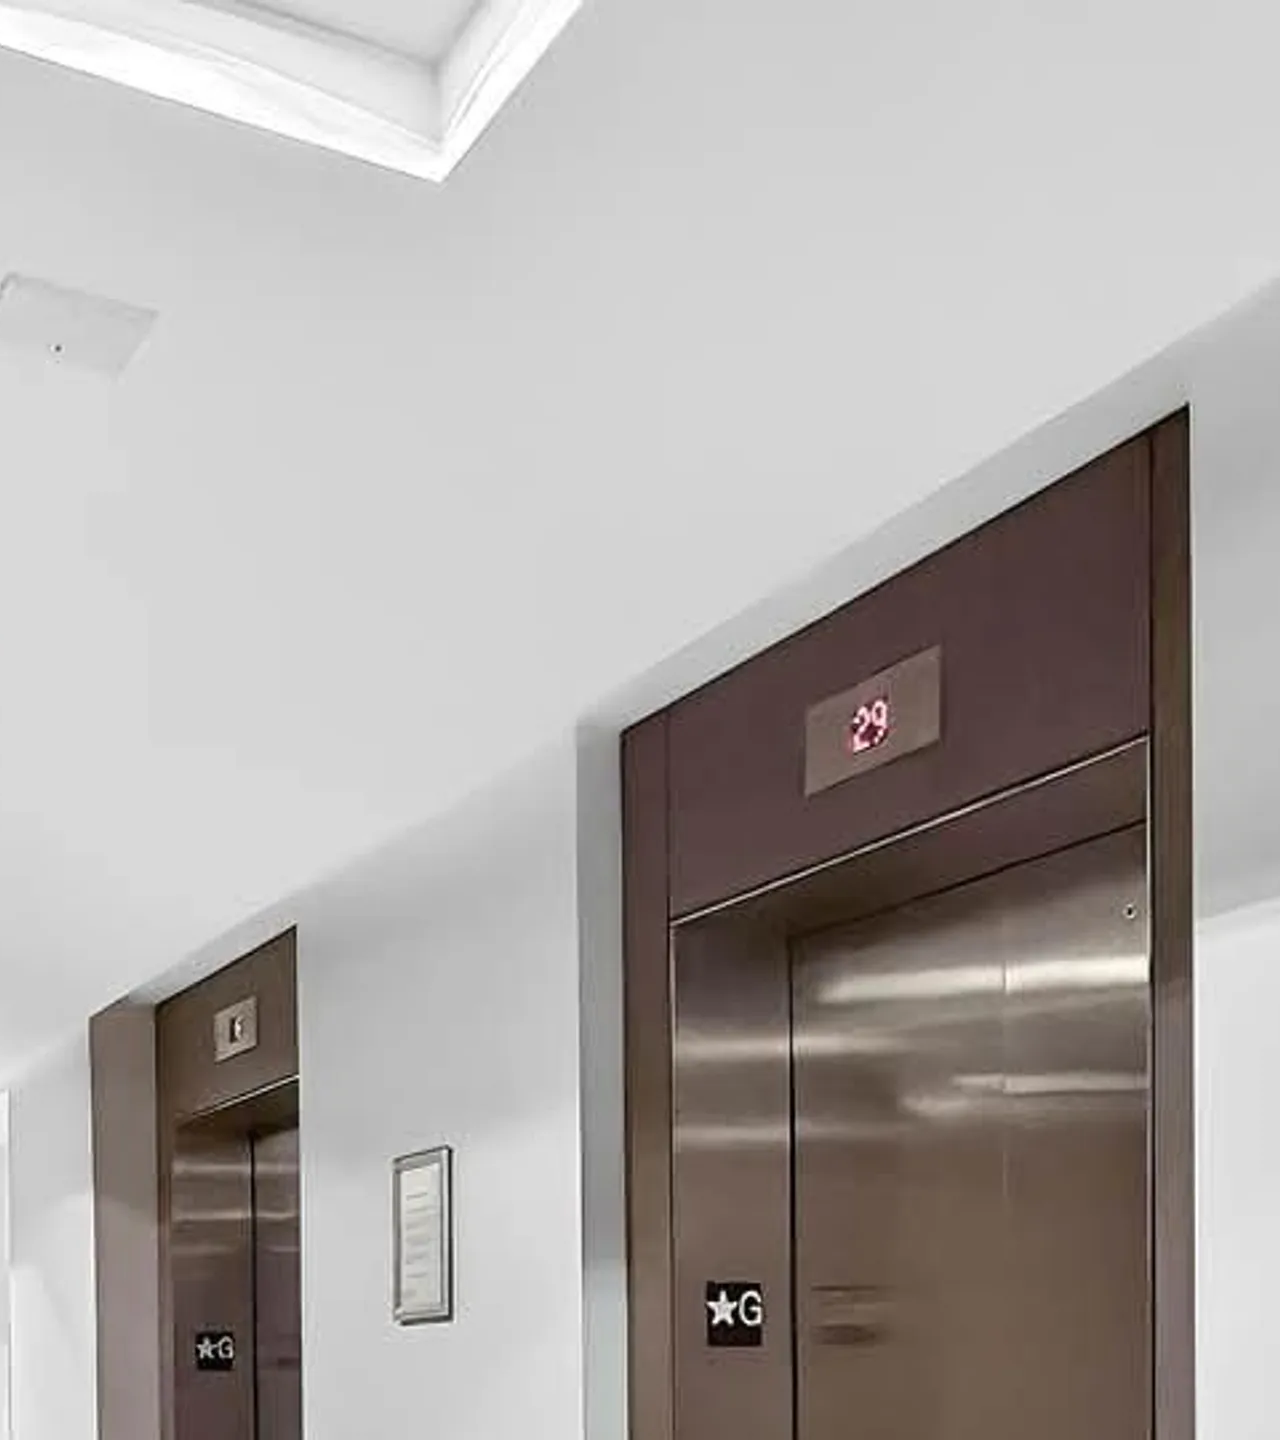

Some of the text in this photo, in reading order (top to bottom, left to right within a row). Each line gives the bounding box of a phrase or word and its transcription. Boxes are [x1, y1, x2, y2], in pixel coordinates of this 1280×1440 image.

[852, 699, 888, 752] 29
[739, 1290, 762, 1327] G
[218, 1335, 234, 1359] G
